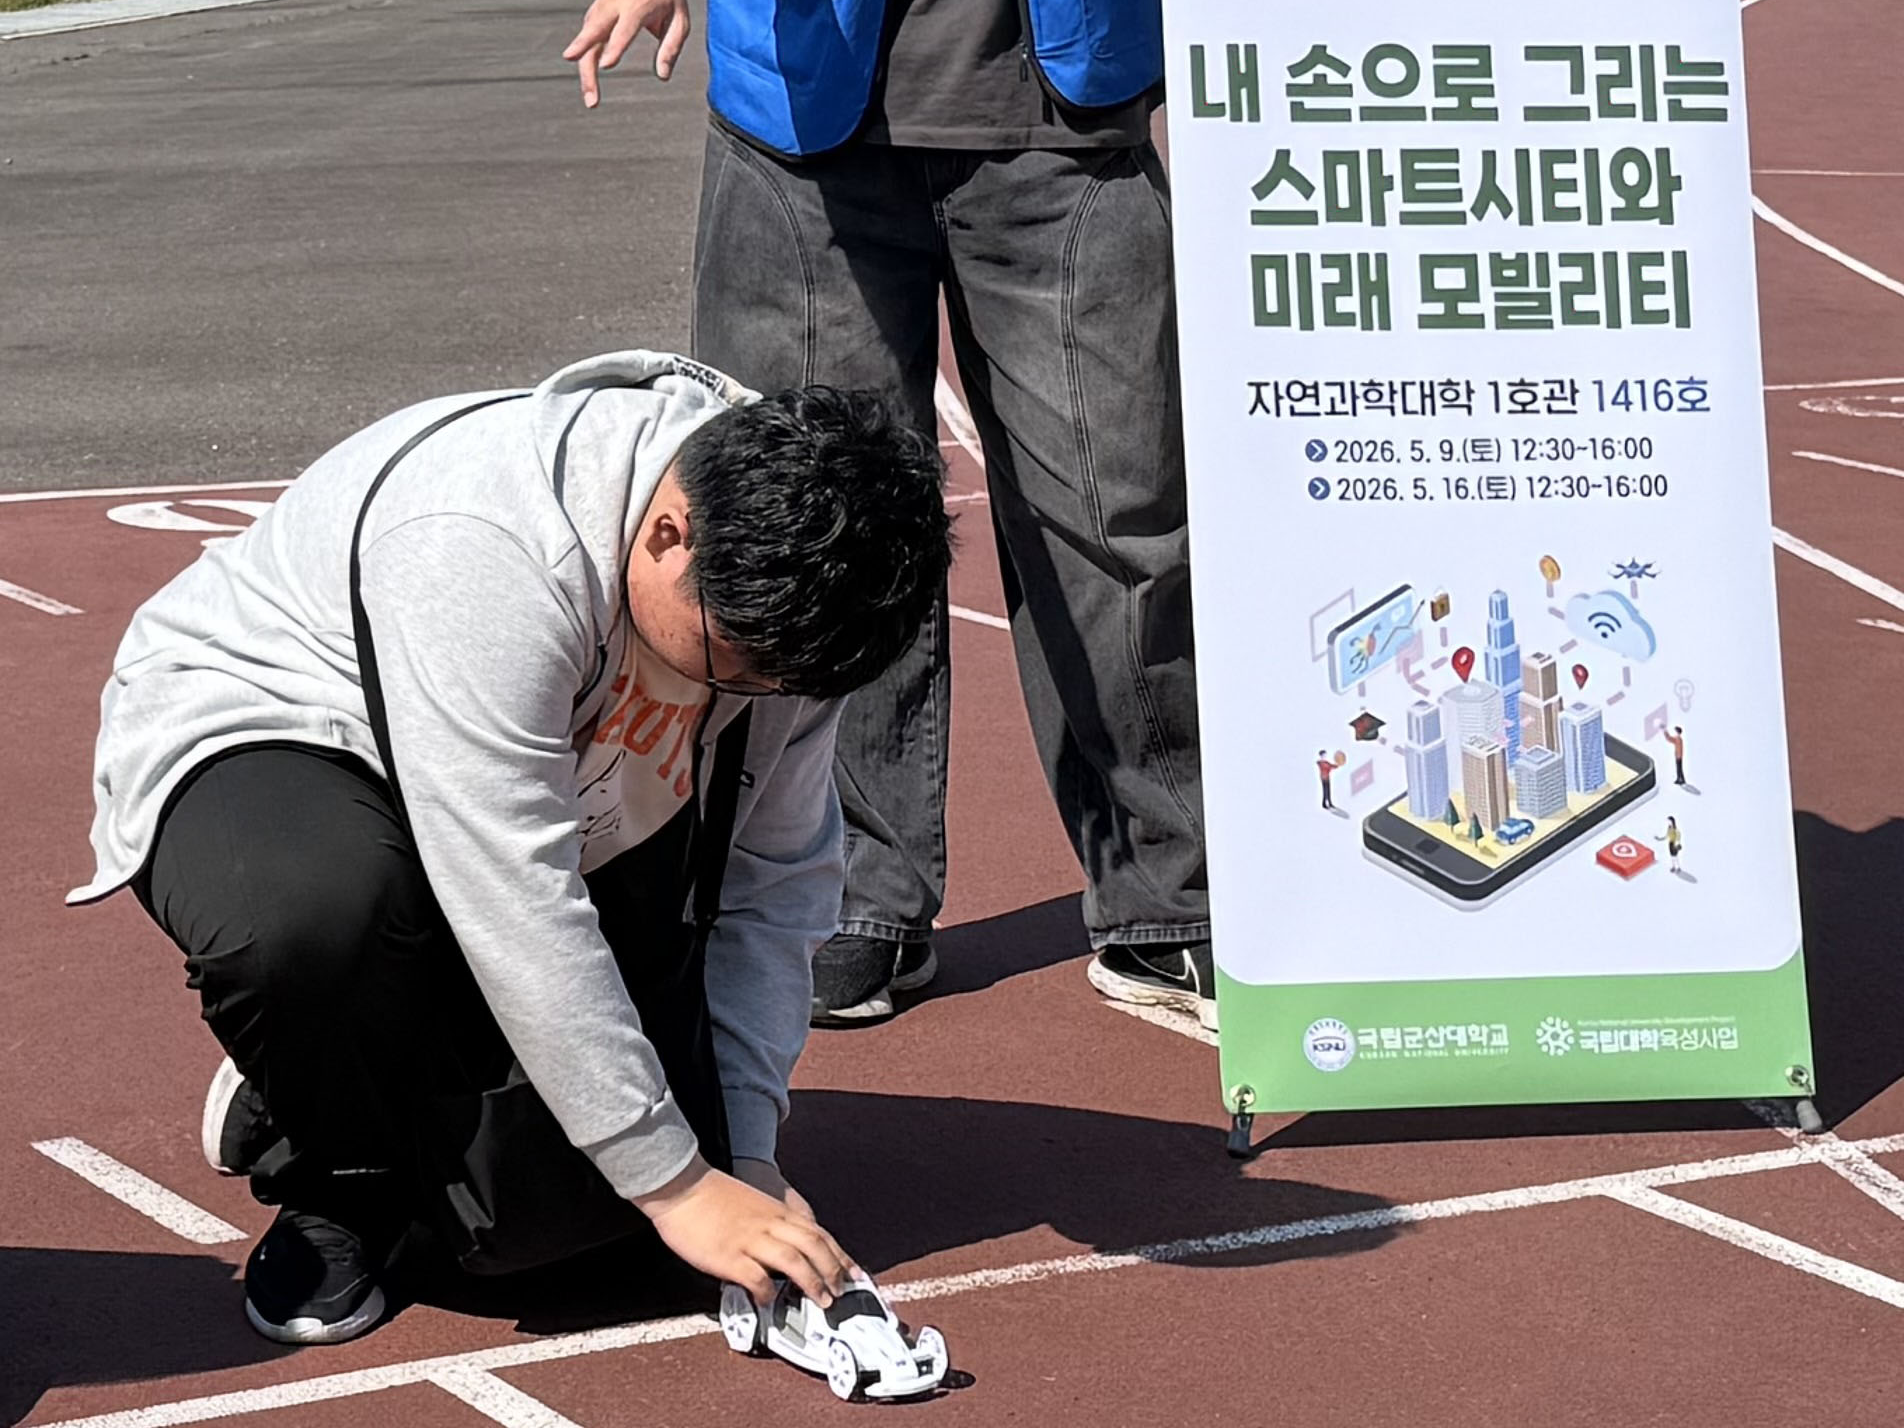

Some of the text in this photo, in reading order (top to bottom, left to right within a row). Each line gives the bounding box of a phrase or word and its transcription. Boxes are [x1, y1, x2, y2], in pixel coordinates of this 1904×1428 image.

[1189, 43, 1729, 123] 내 손으로 그리는
[1250, 146, 1683, 227] 스마트시티와
[1250, 250, 1692, 332] 미래 모빌리티
[1246, 375, 1712, 418] 자연과학대학 1호관 1416호
[1334, 438, 1402, 463] 2026.
[1410, 438, 1432, 462] 5.
[1439, 436, 1503, 463] 9.(토)
[1337, 477, 1405, 502] 2026.
[1413, 477, 1435, 502] 5.
[1444, 476, 1518, 502] 16.(토)
[1357, 1023, 1510, 1050] 국립군산대학교
[1579, 1026, 1740, 1054] 국립대학육성사업
